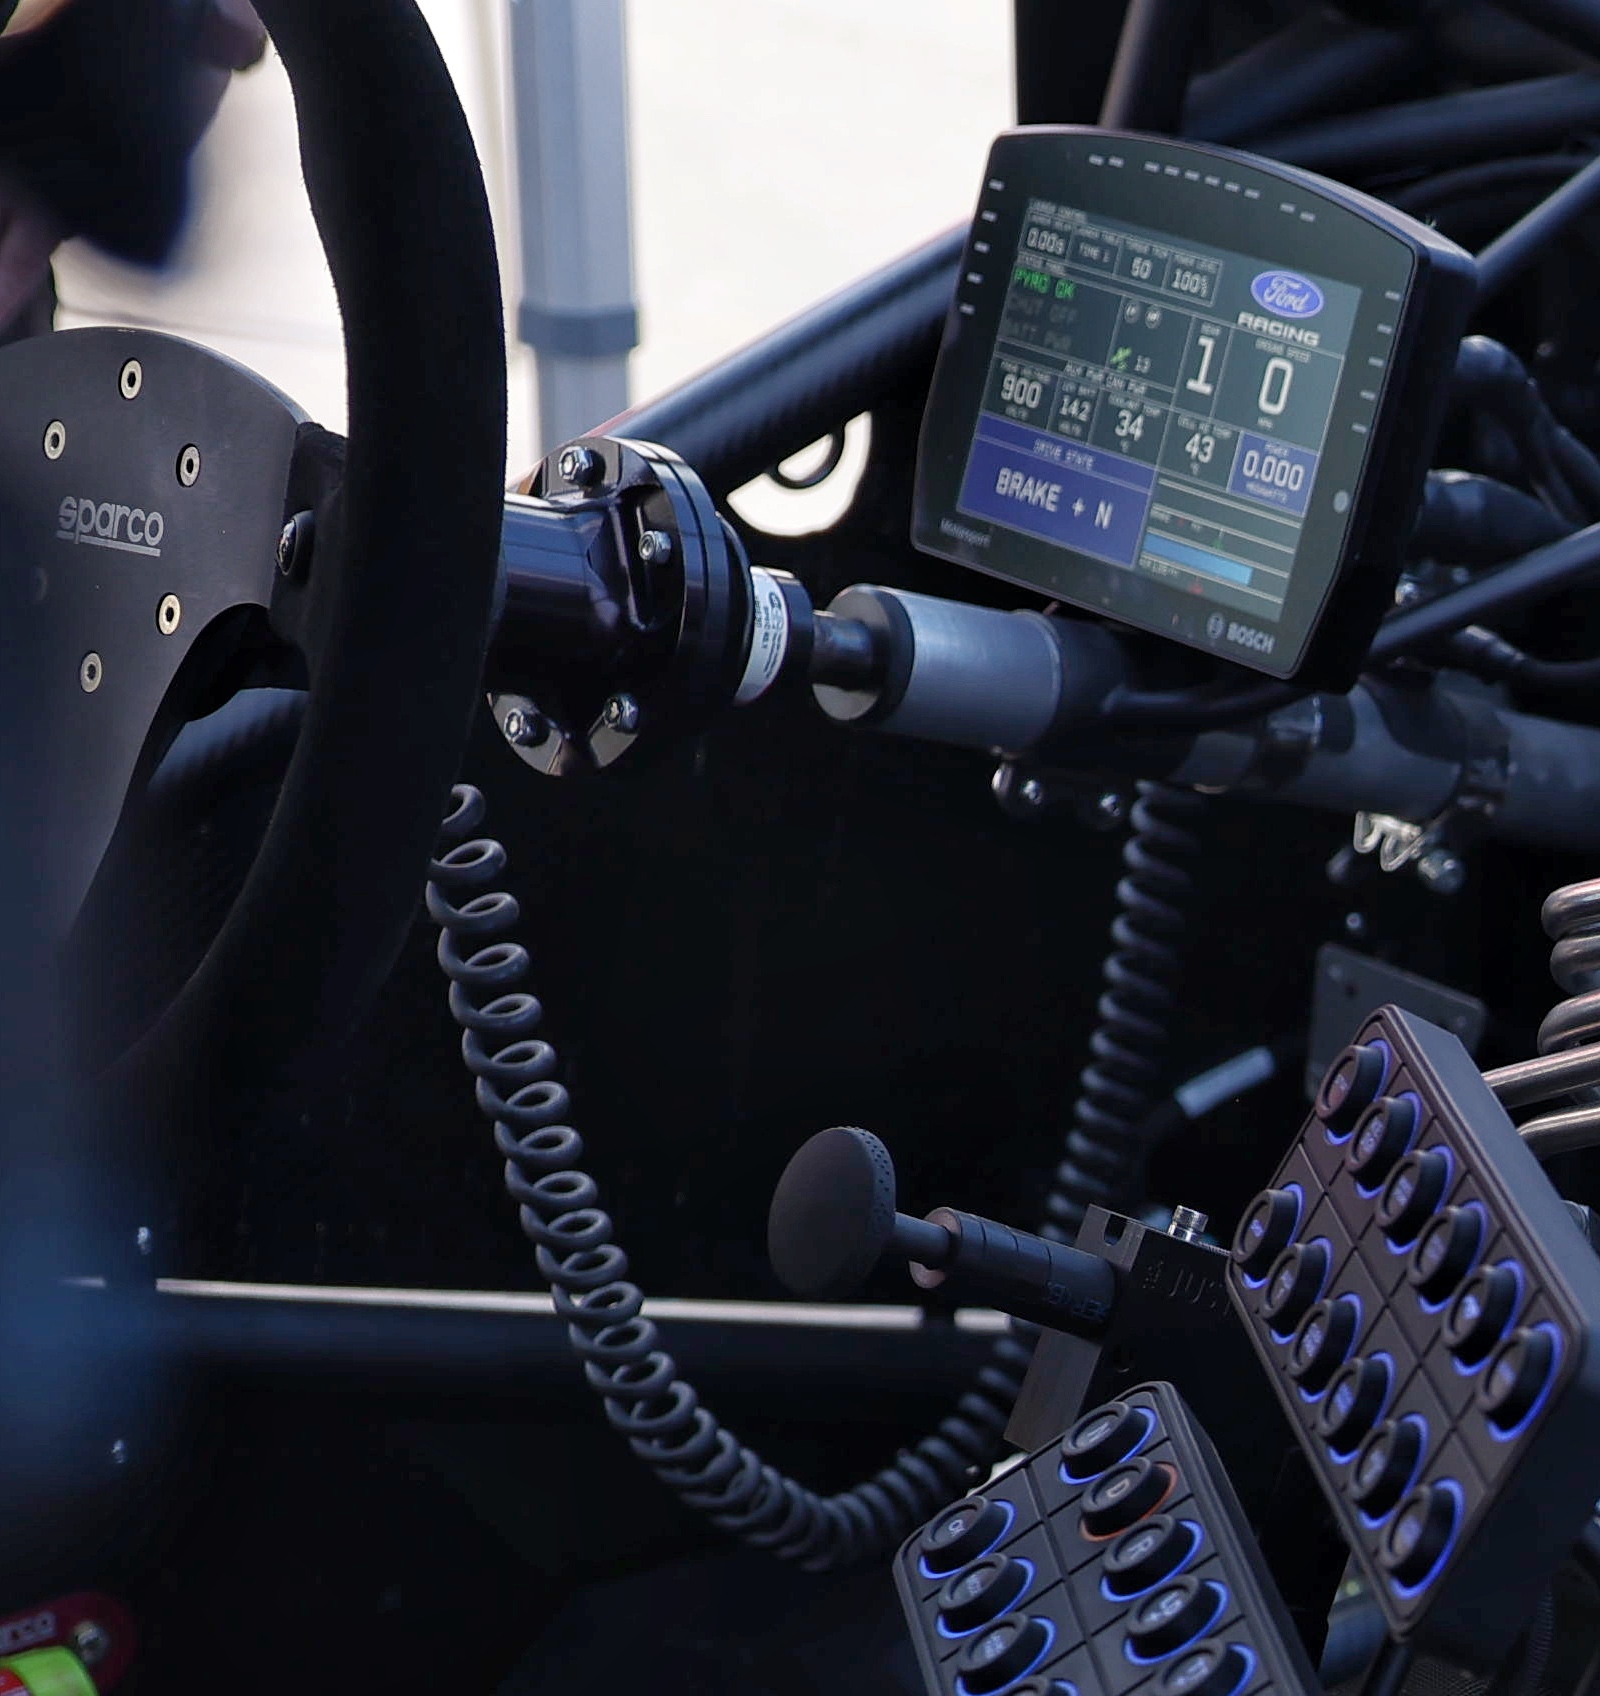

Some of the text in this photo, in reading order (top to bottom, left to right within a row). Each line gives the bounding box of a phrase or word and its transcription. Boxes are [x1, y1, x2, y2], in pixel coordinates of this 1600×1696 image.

[1013, 266, 1076, 299] PYRO OK
[1237, 311, 1322, 347] RACING
[1186, 335, 1215, 395] 1
[1000, 373, 1043, 409] 900
[1258, 356, 1293, 416] 0
[1115, 409, 1145, 441] 34
[1185, 432, 1216, 464] 43
[1242, 450, 1304, 492] 0.000
[995, 466, 1113, 530] BRAKE + N
[57, 495, 164, 546] sparco
[1226, 621, 1276, 654] BOSCH
[1105, 1478, 1130, 1497] D
